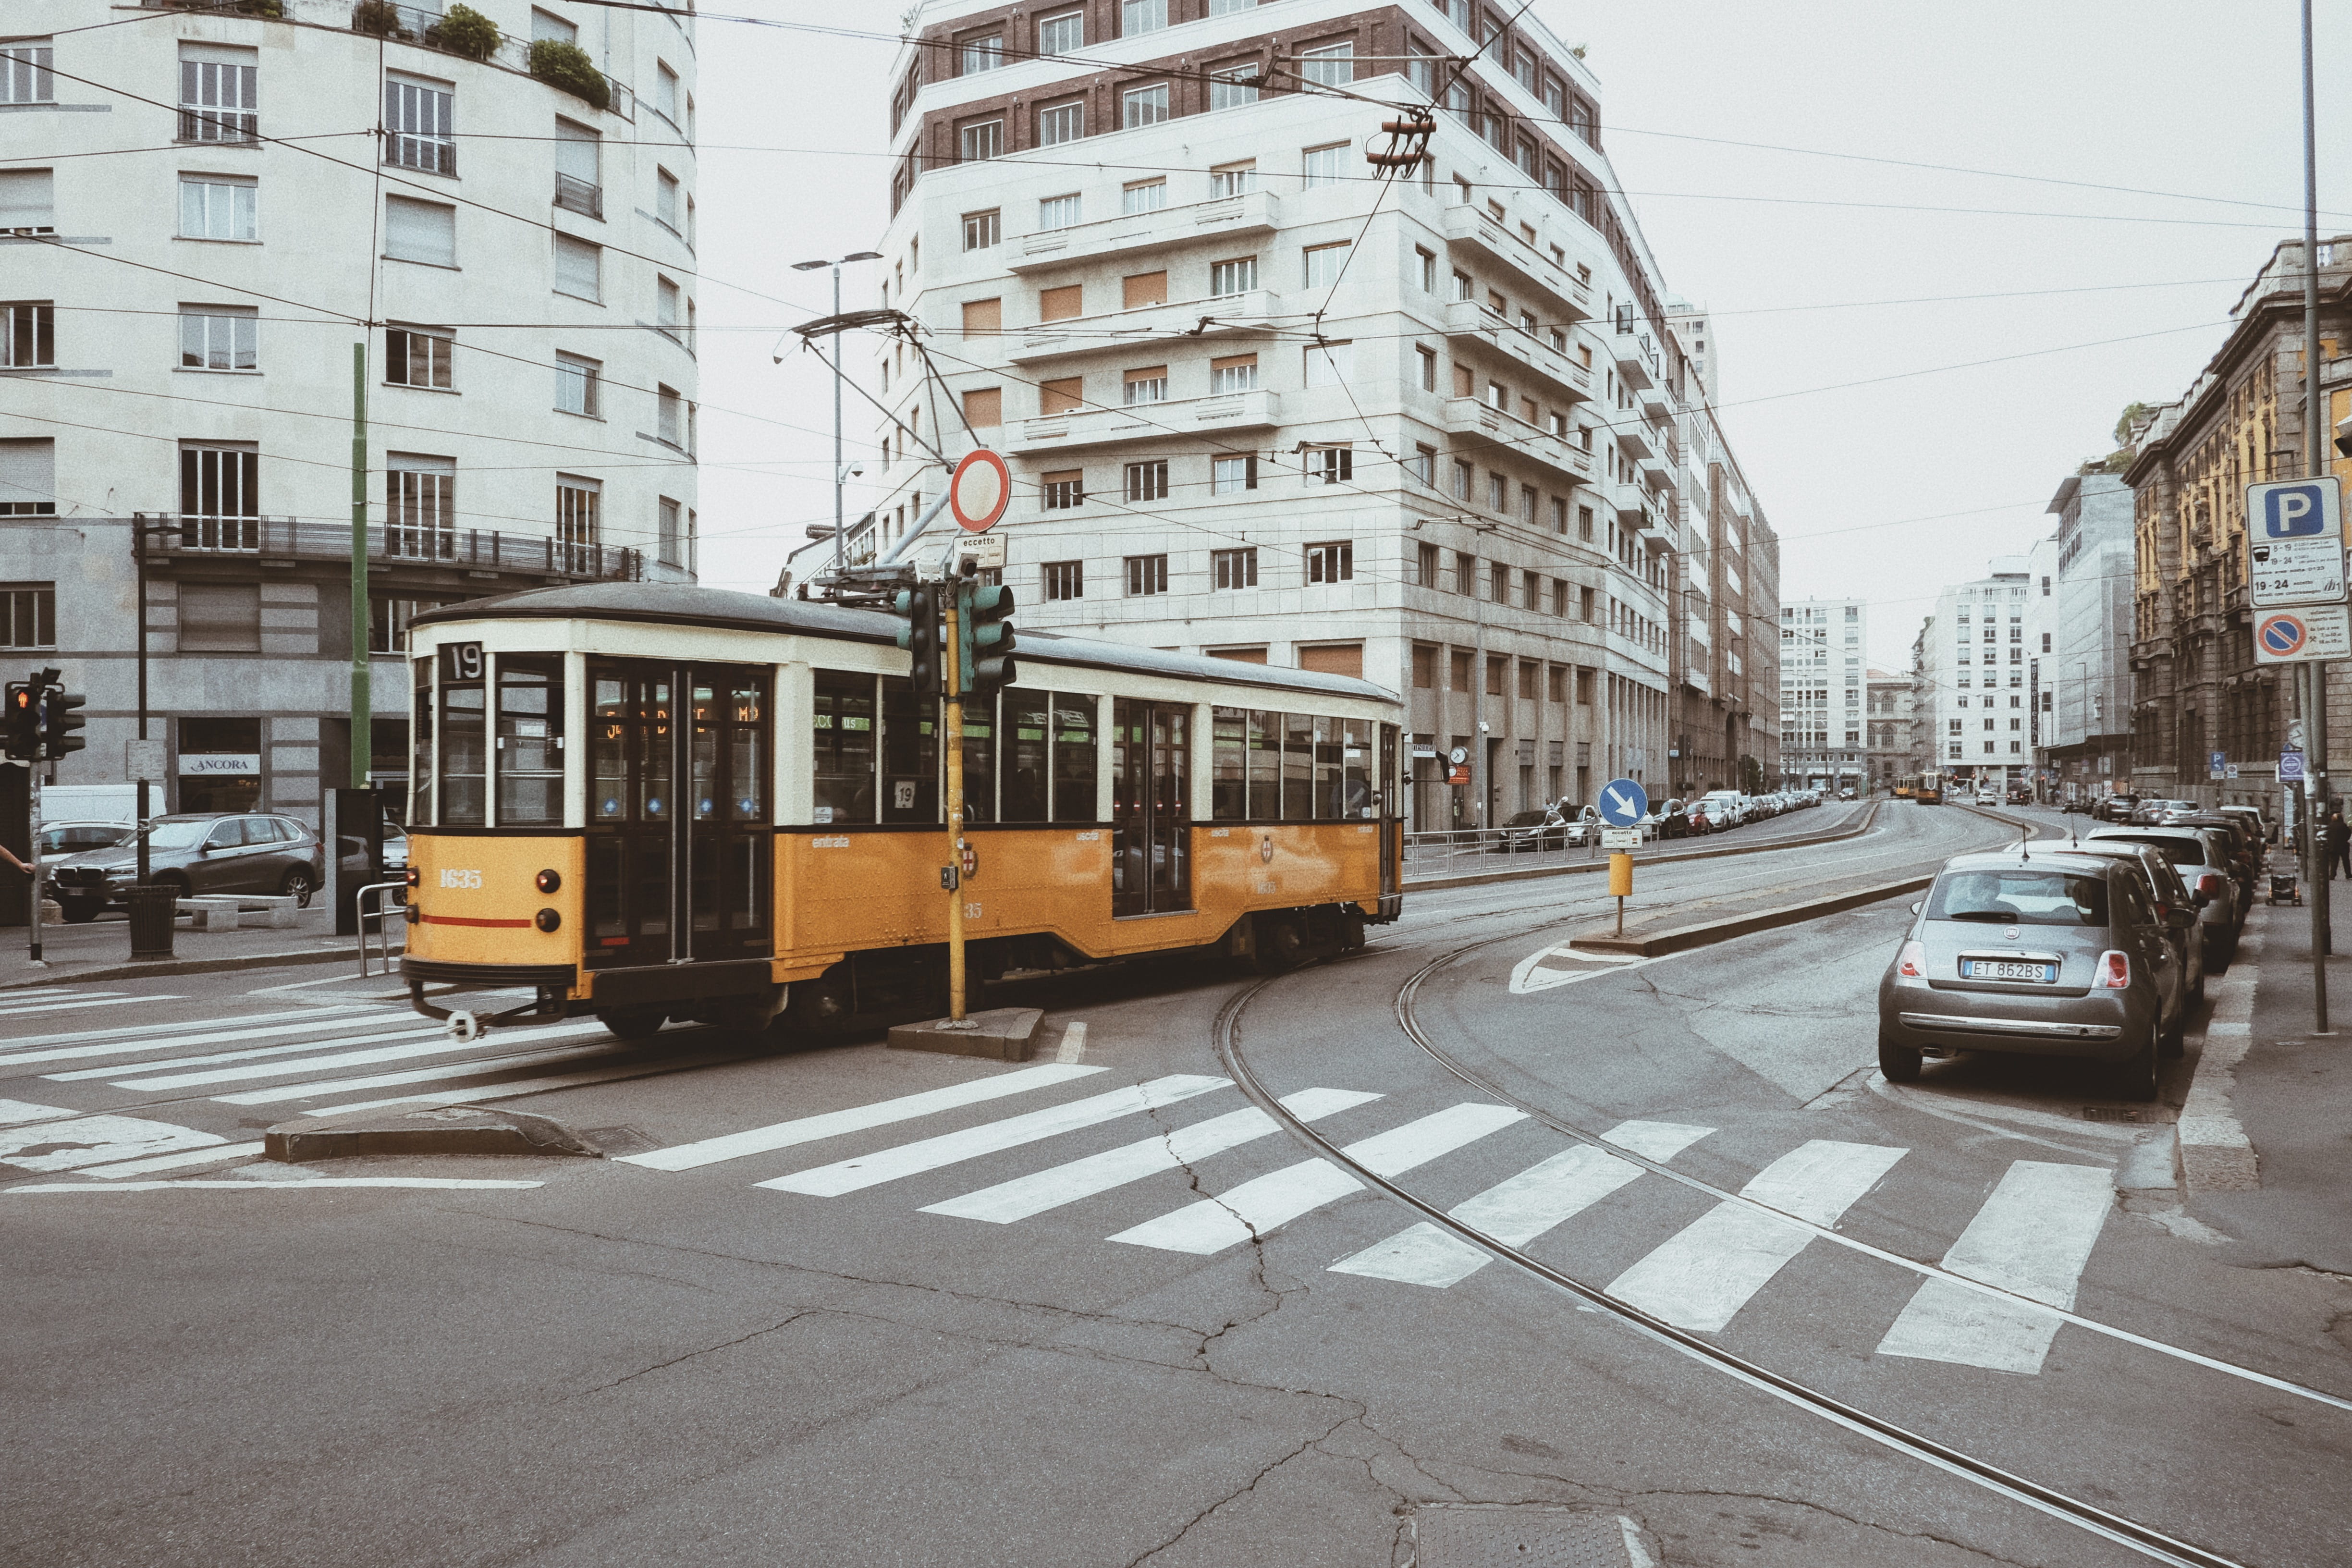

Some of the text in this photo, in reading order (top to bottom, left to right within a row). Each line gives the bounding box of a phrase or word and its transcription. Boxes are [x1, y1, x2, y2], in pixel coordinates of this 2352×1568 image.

[2278, 493, 2311, 531] P
[963, 538, 995, 546] eccetto
[452, 644, 482, 679] 19
[191, 760, 248, 772] ANCORA
[900, 788, 912, 802] 19
[440, 869, 482, 889] 1635
[964, 903, 982, 919] 35
[1974, 962, 2044, 978] ET 862BS
